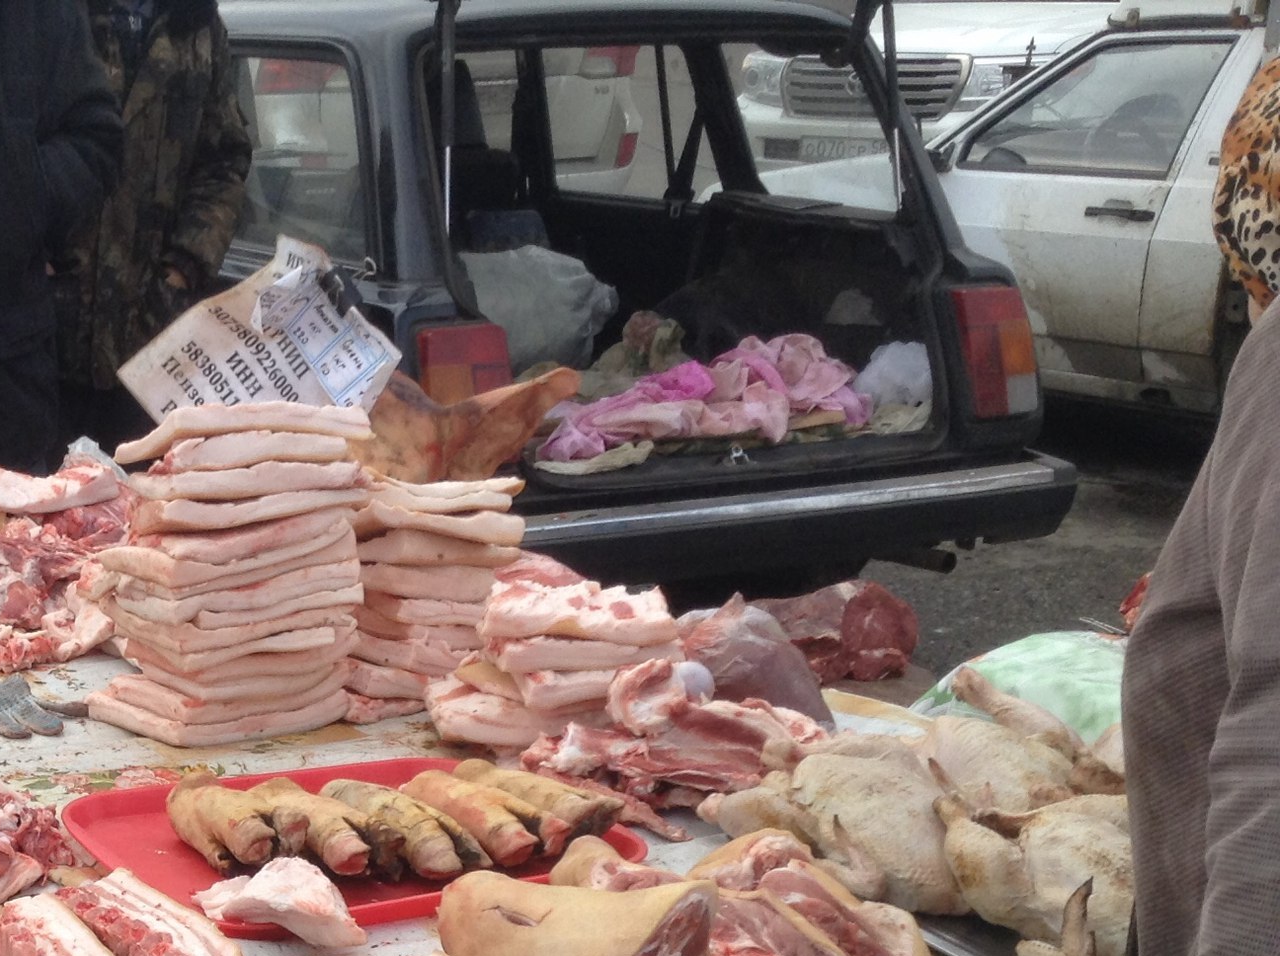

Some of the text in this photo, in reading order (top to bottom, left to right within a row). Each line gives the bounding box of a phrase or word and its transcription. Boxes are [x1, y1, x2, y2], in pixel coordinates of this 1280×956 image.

[181, 340, 241, 407] 58380511
[208, 306, 300, 403] 3075809226000
[225, 350, 264, 398] ИНН
[160, 399, 178, 415] Р
[161, 356, 206, 407] Пензе
